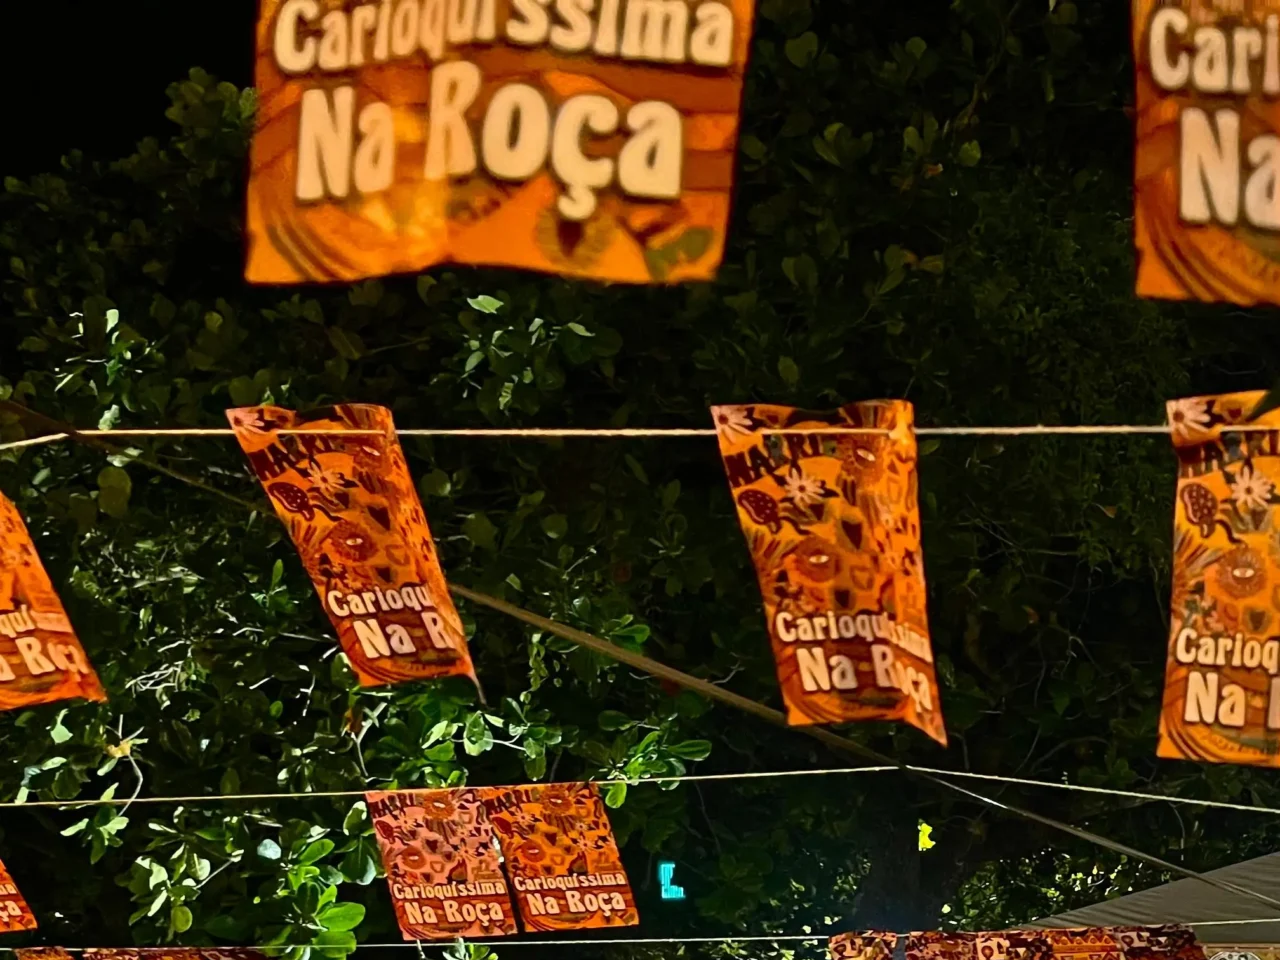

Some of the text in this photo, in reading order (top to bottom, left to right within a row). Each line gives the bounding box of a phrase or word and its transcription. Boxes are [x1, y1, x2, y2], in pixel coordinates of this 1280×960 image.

[296, 61, 683, 220] Na Roça
[353, 619, 416, 659] Na
[796, 647, 858, 691] Na
[1183, 672, 1246, 727] Na
[393, 881, 506, 900] Carioquíssima
[514, 873, 626, 892] Carioquíssima
[404, 900, 504, 926] Na Roça
[526, 891, 626, 916] Na Roça
